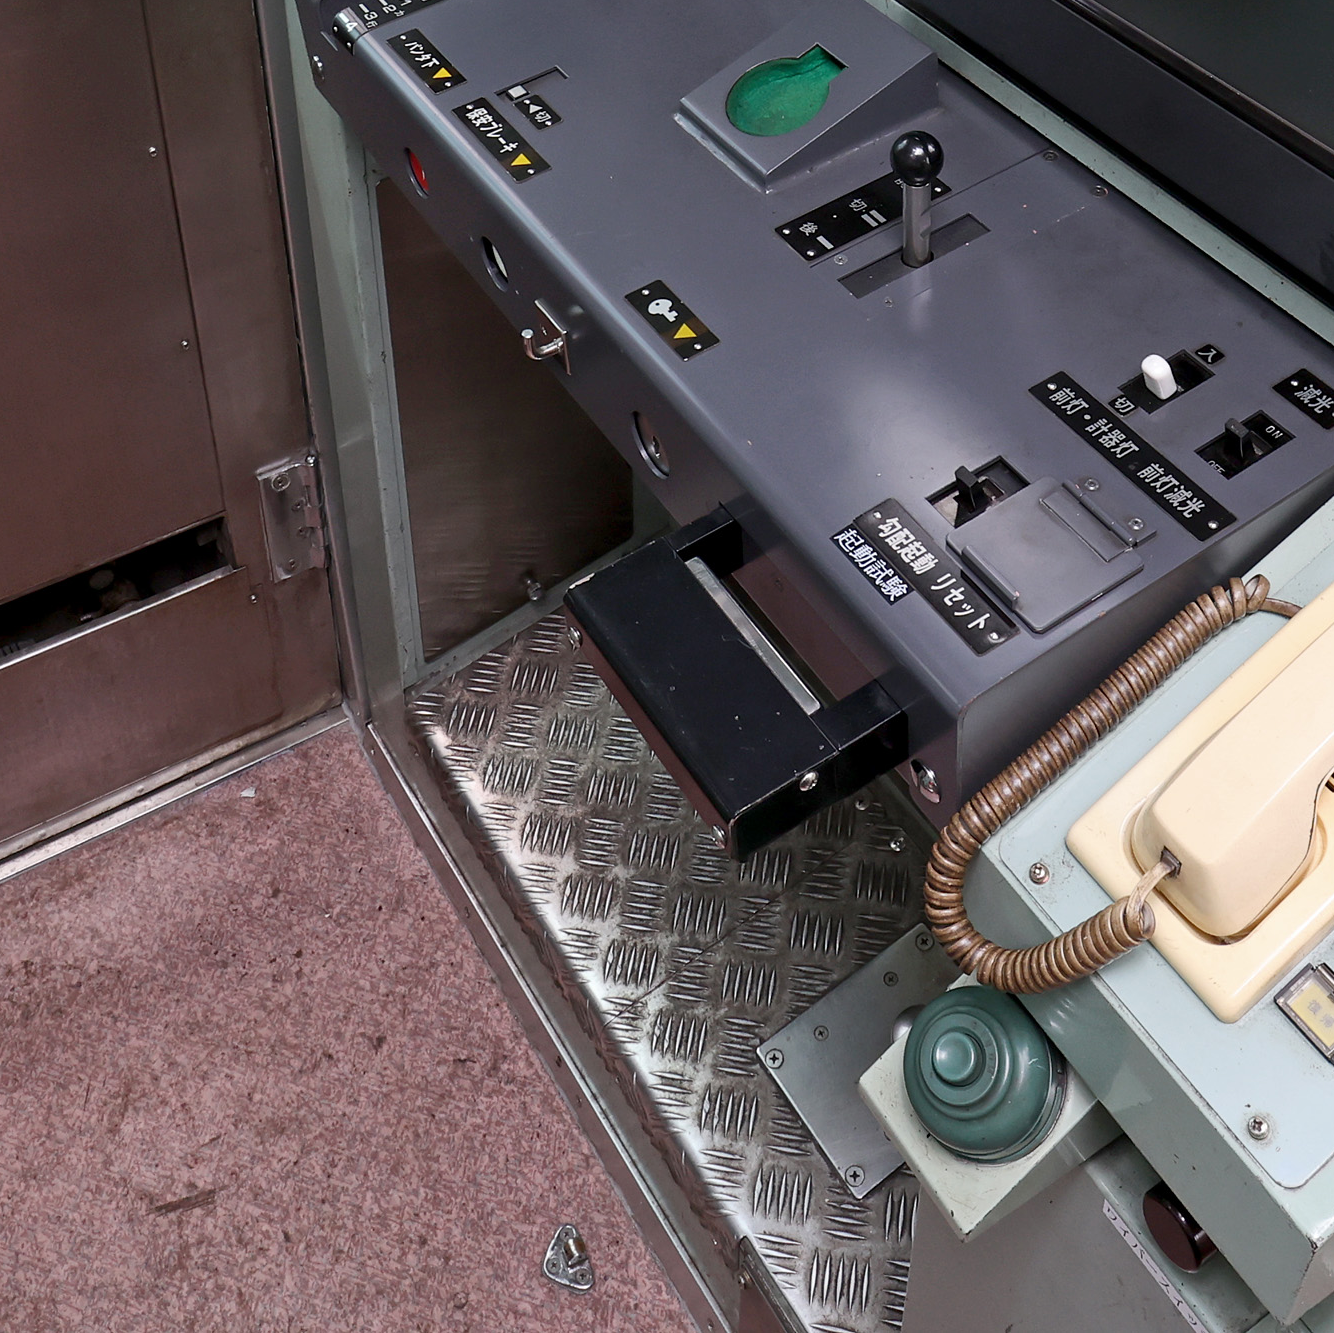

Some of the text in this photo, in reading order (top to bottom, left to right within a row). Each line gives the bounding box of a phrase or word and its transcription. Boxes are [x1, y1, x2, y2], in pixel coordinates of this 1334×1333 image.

[382, 4, 397, 14] 2
[401, 0, 413, 7] 1
[364, 12, 378, 21] 3
[345, 22, 358, 33] 4
[534, 110, 552, 124] 切
[465, 107, 519, 154] 保安ブレーキ
[799, 221, 819, 237] 後
[1198, 347, 1220, 363] 入
[1114, 397, 1135, 414] 切
[1049, 387, 1140, 459] 前灯・計器灯
[1265, 424, 1284, 440] ON
[1137, 462, 1208, 520] 前灯減光
[833, 527, 909, 602] 起動試験
[878, 516, 992, 631] 勾配起動 リセット
[1107, 1207, 1209, 1333] ワイパースイッ
